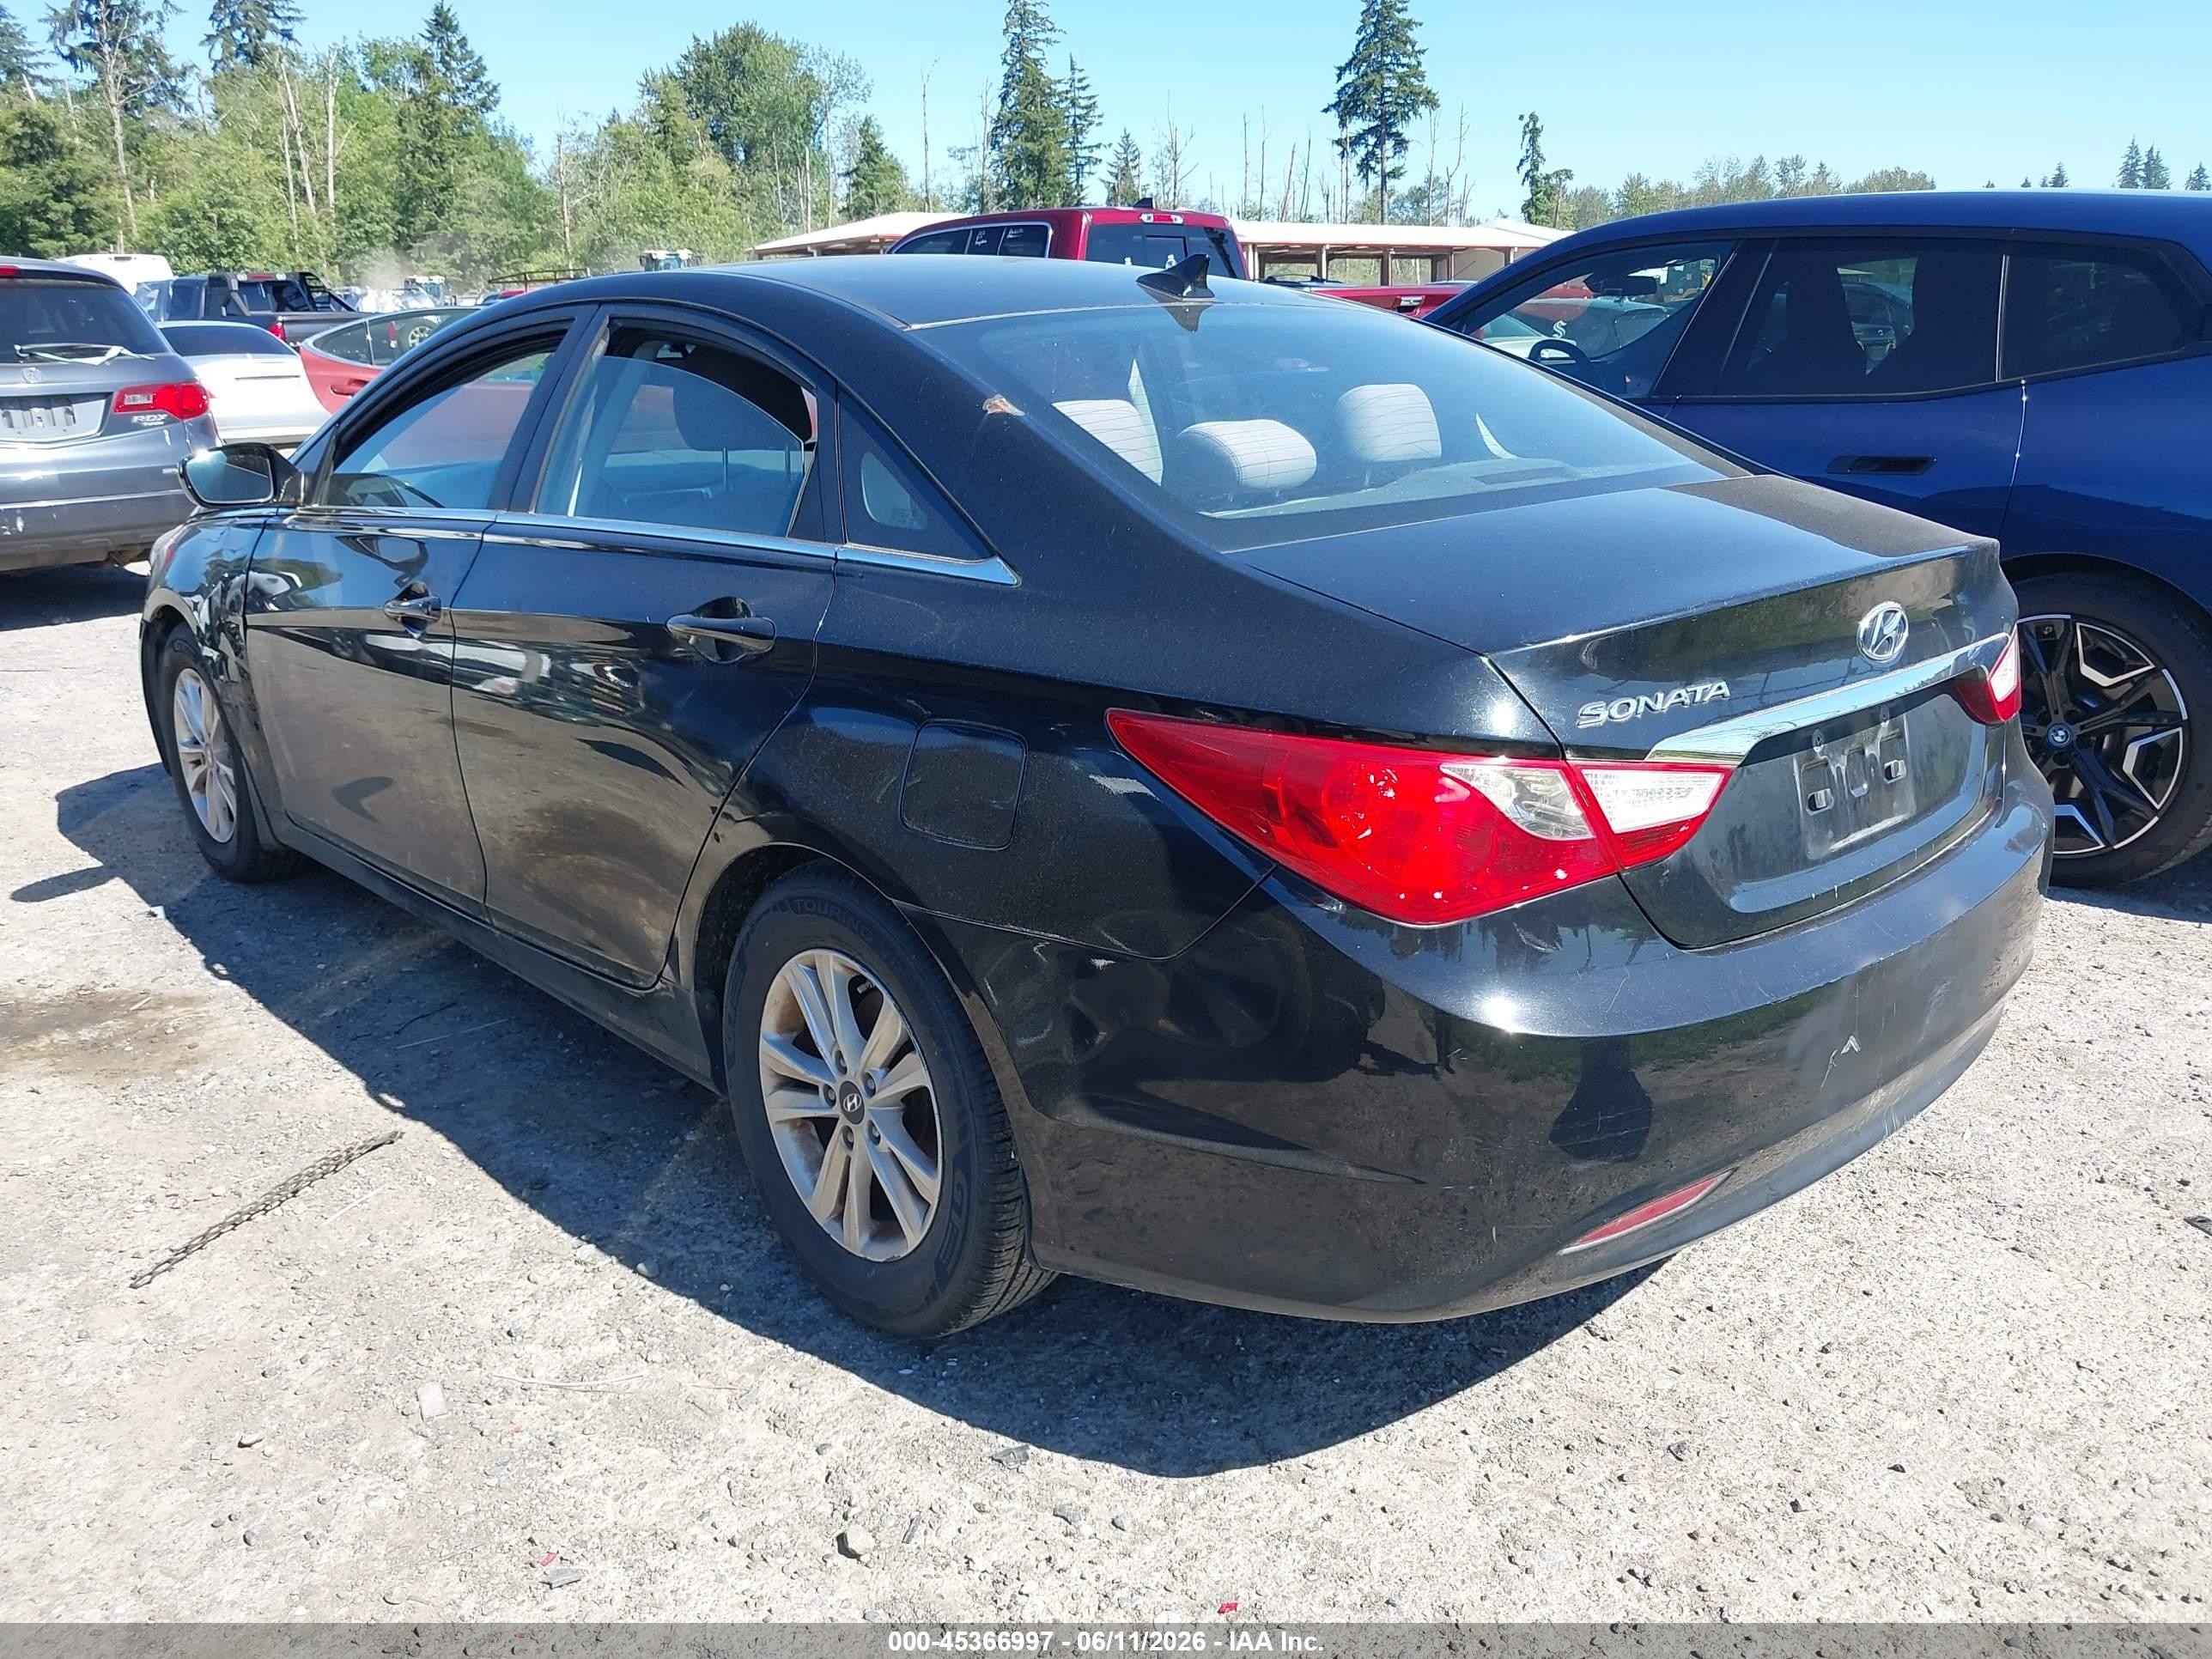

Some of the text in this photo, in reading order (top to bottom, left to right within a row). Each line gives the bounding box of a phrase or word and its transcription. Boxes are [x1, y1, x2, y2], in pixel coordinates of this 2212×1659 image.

[131, 414, 168, 423] RDX
[1577, 680, 1731, 728] SONATA
[794, 900, 874, 945] TOURING
